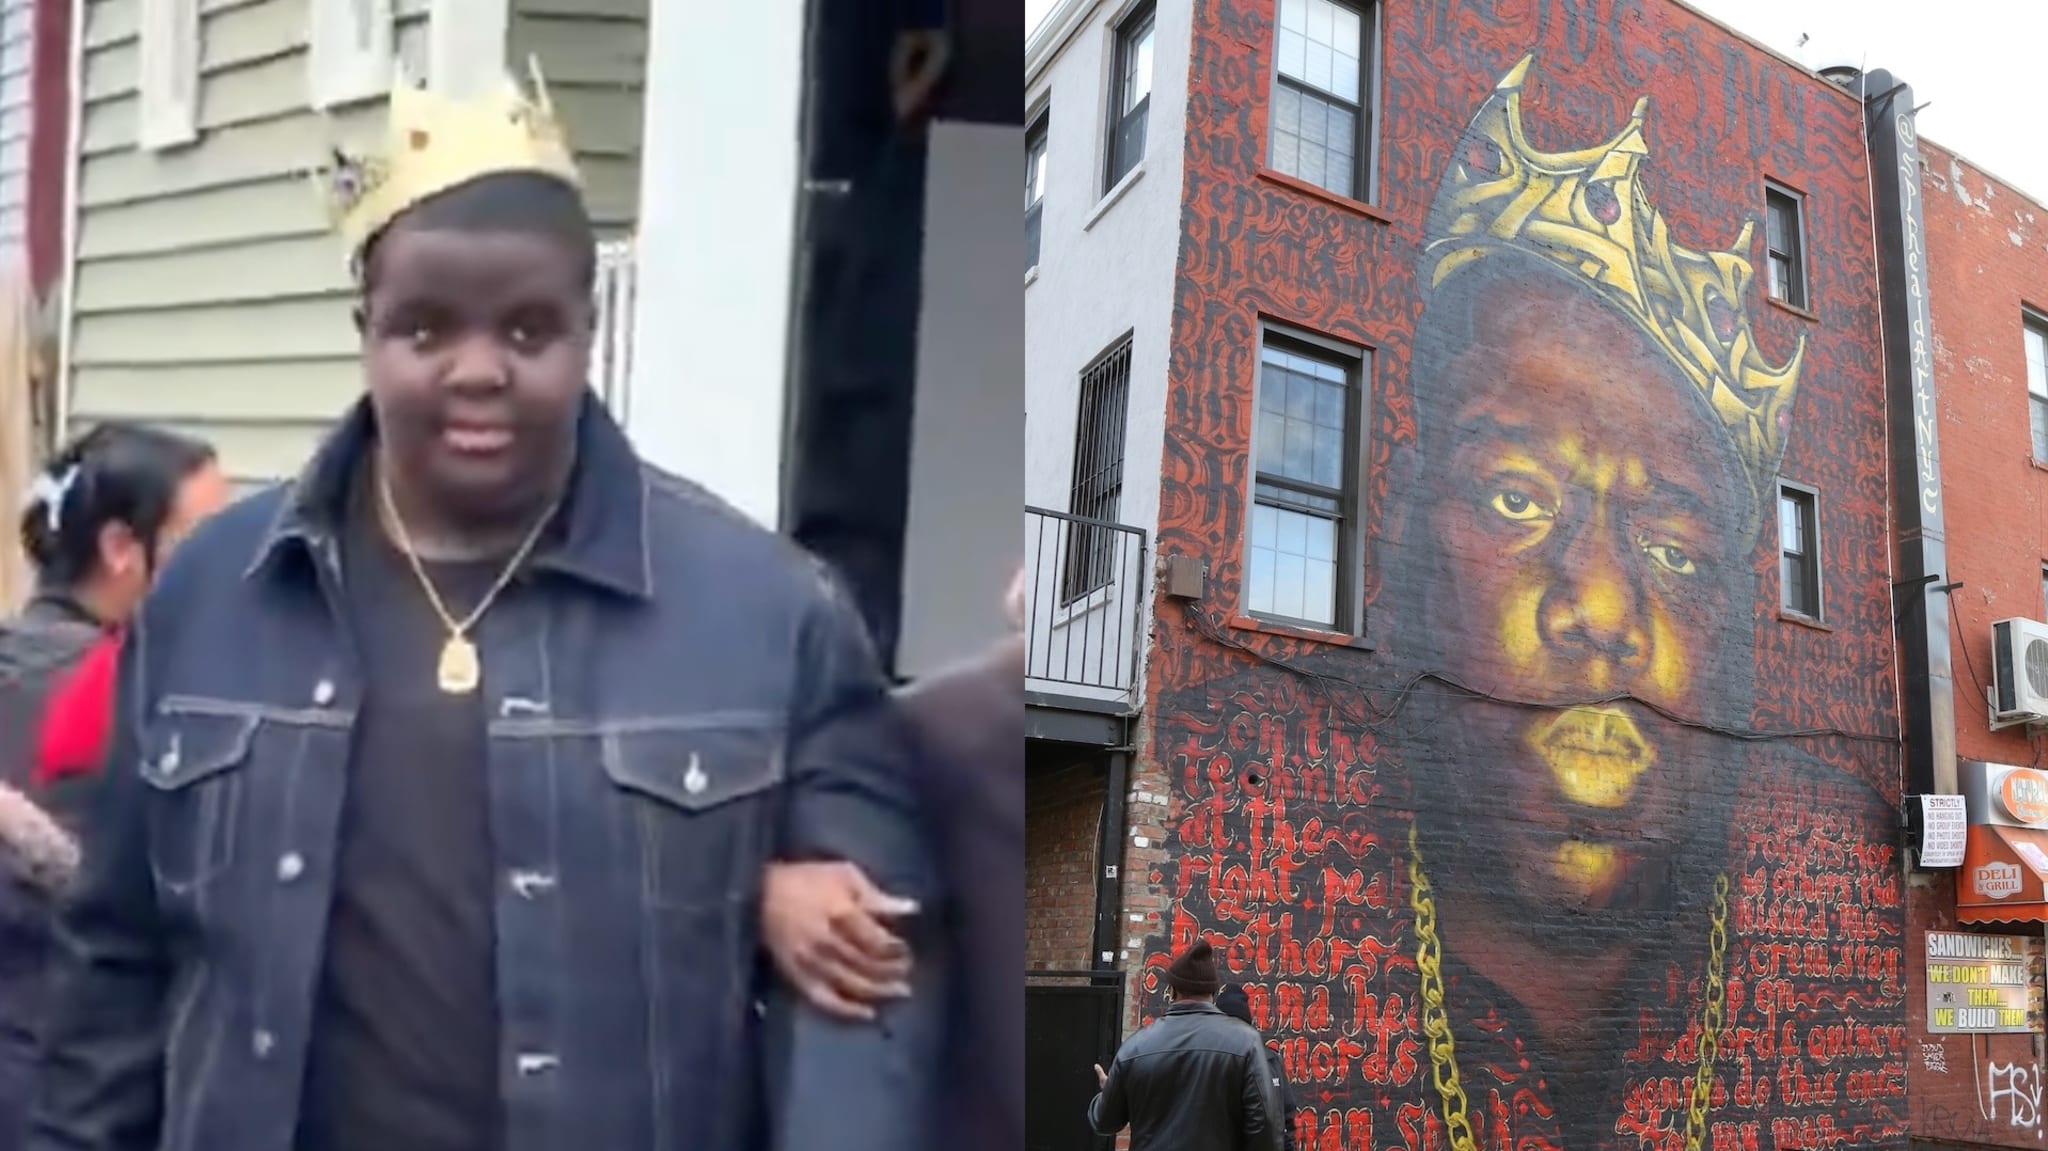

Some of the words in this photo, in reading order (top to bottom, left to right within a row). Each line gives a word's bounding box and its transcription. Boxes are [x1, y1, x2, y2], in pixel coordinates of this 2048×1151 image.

[1929, 798, 1961, 808] STRICTLY
[1977, 868, 2018, 881] DELI
[1178, 850, 1306, 921] right
[1986, 880, 2019, 891] GRILL
[1929, 964, 1950, 983] WE
[1951, 966, 1988, 984] DON'T
[1990, 964, 2024, 984] MAKE
[1934, 1007, 1954, 1026] WE
[1957, 1008, 1996, 1029] BUILD
[1998, 1008, 2024, 1027] THEM
